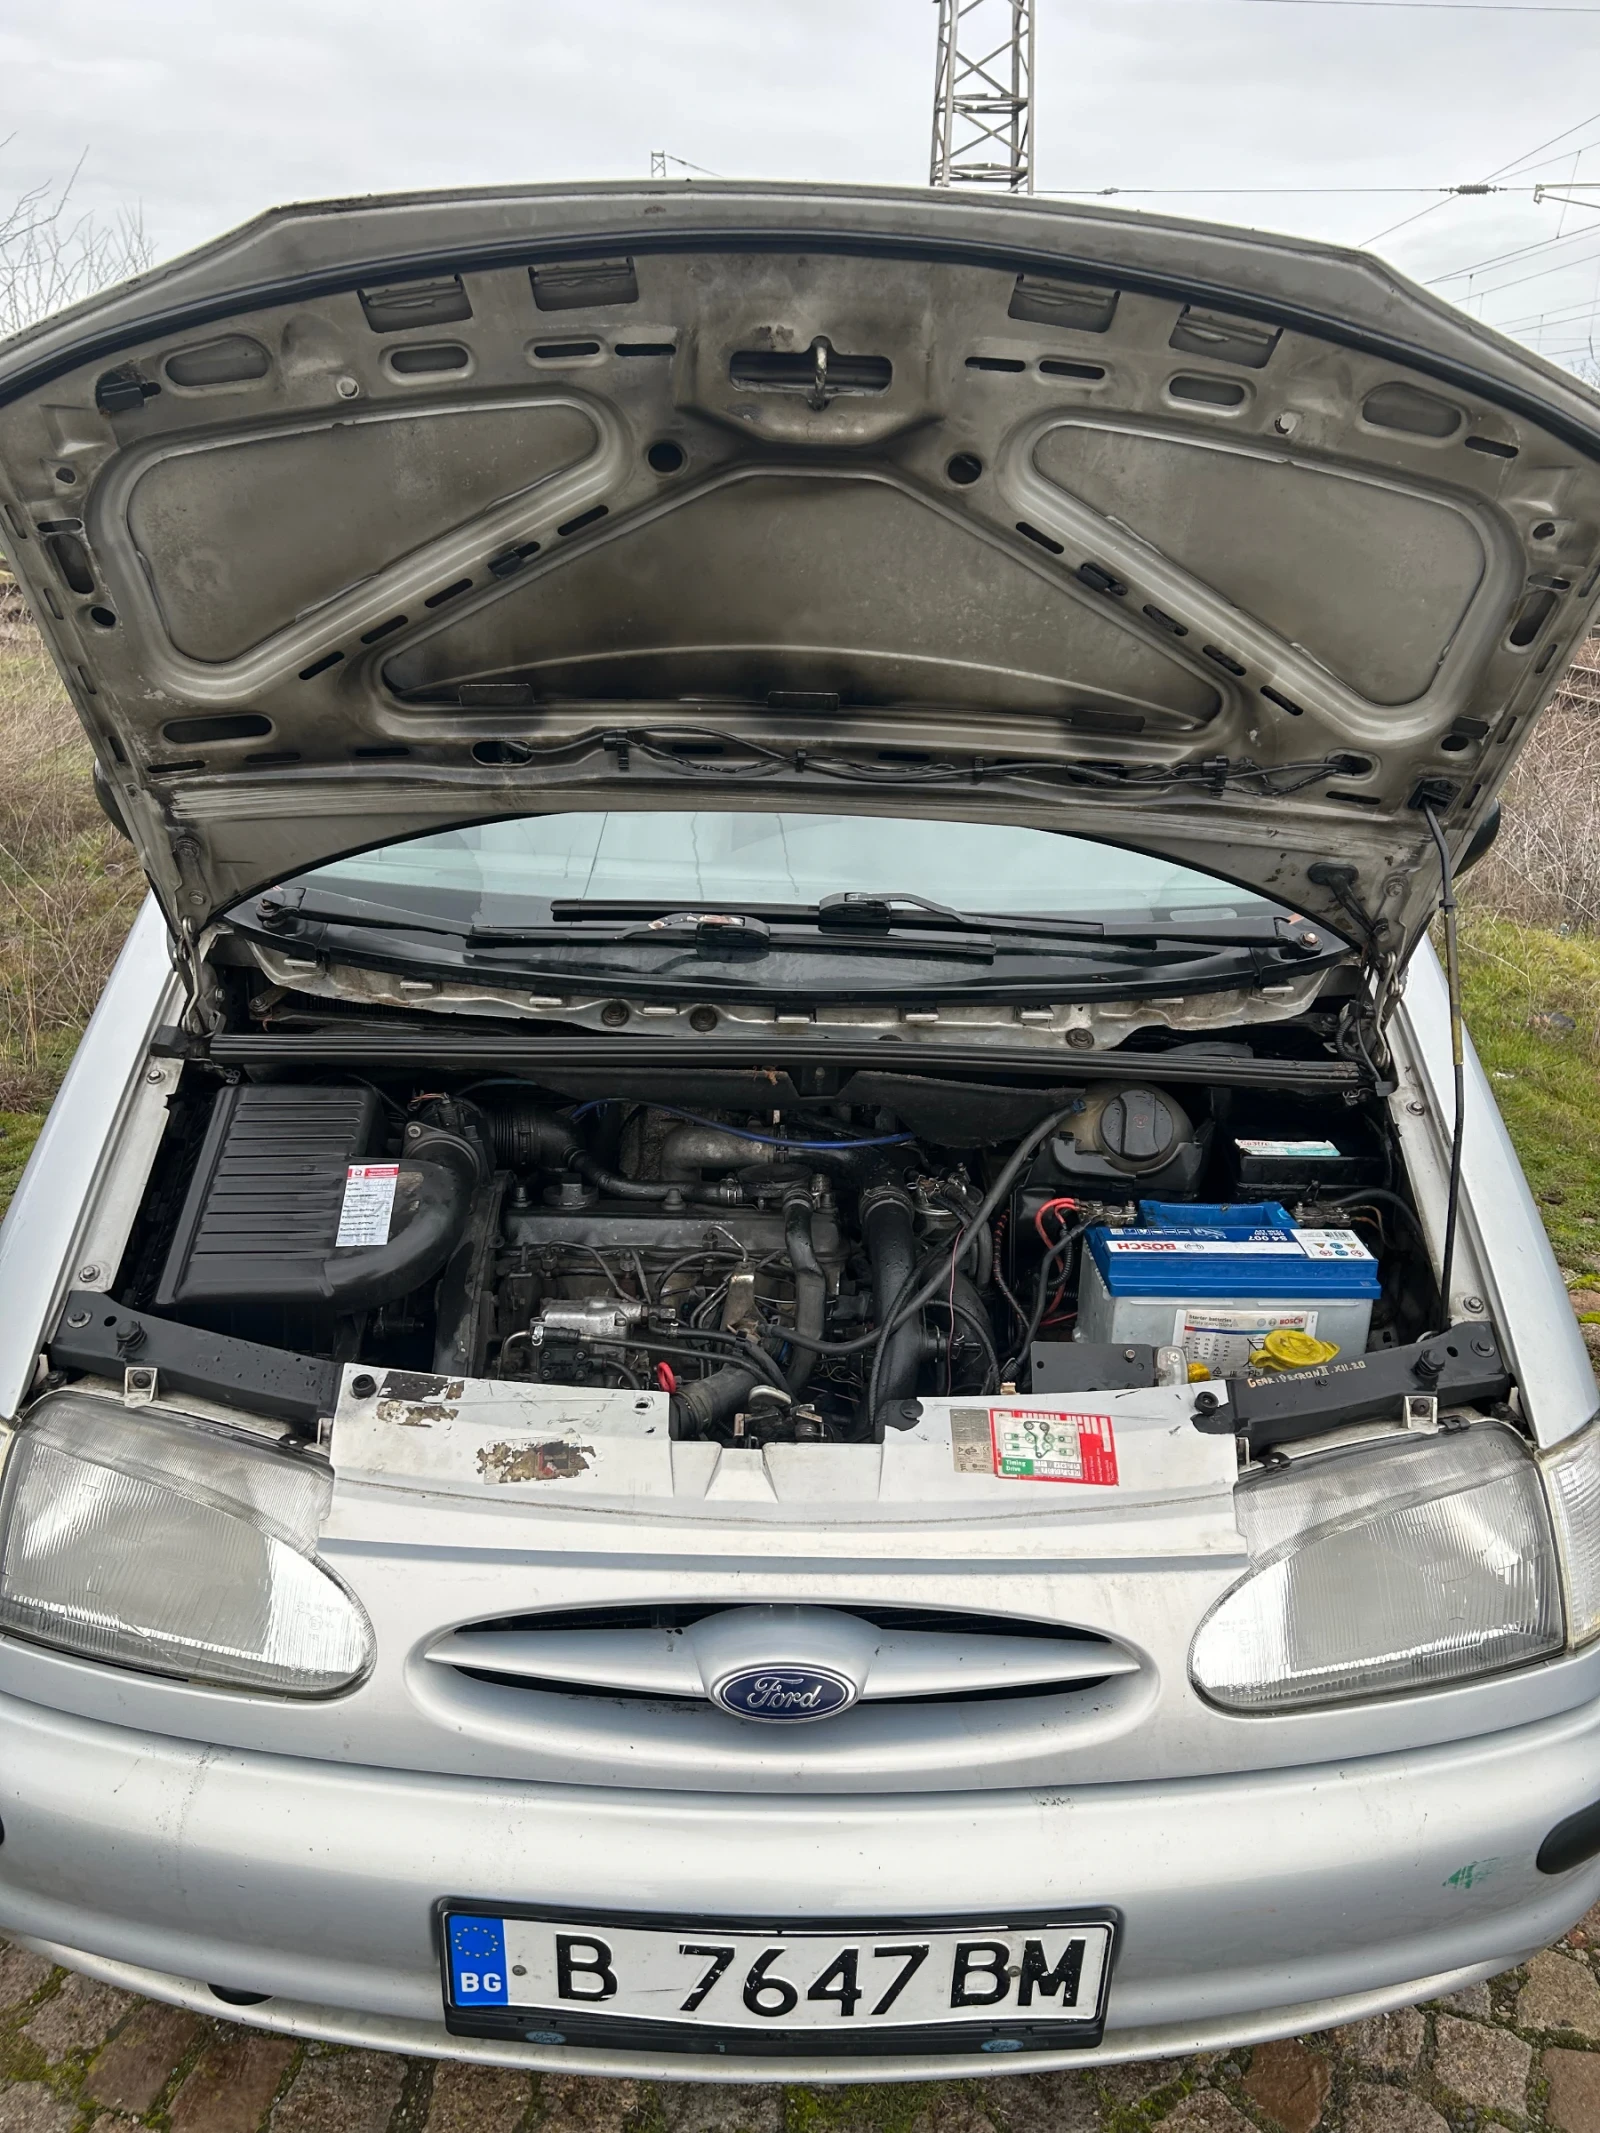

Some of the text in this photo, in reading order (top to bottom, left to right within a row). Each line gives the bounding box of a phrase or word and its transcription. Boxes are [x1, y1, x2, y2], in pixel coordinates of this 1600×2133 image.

[1280, 1317, 1304, 1325] BOSCH
[1006, 1459, 1026, 1467] Timing
[747, 1676, 822, 1708] Ford
[460, 1972, 502, 1993] BG
[555, 1931, 1086, 2017] B 7647 BM
